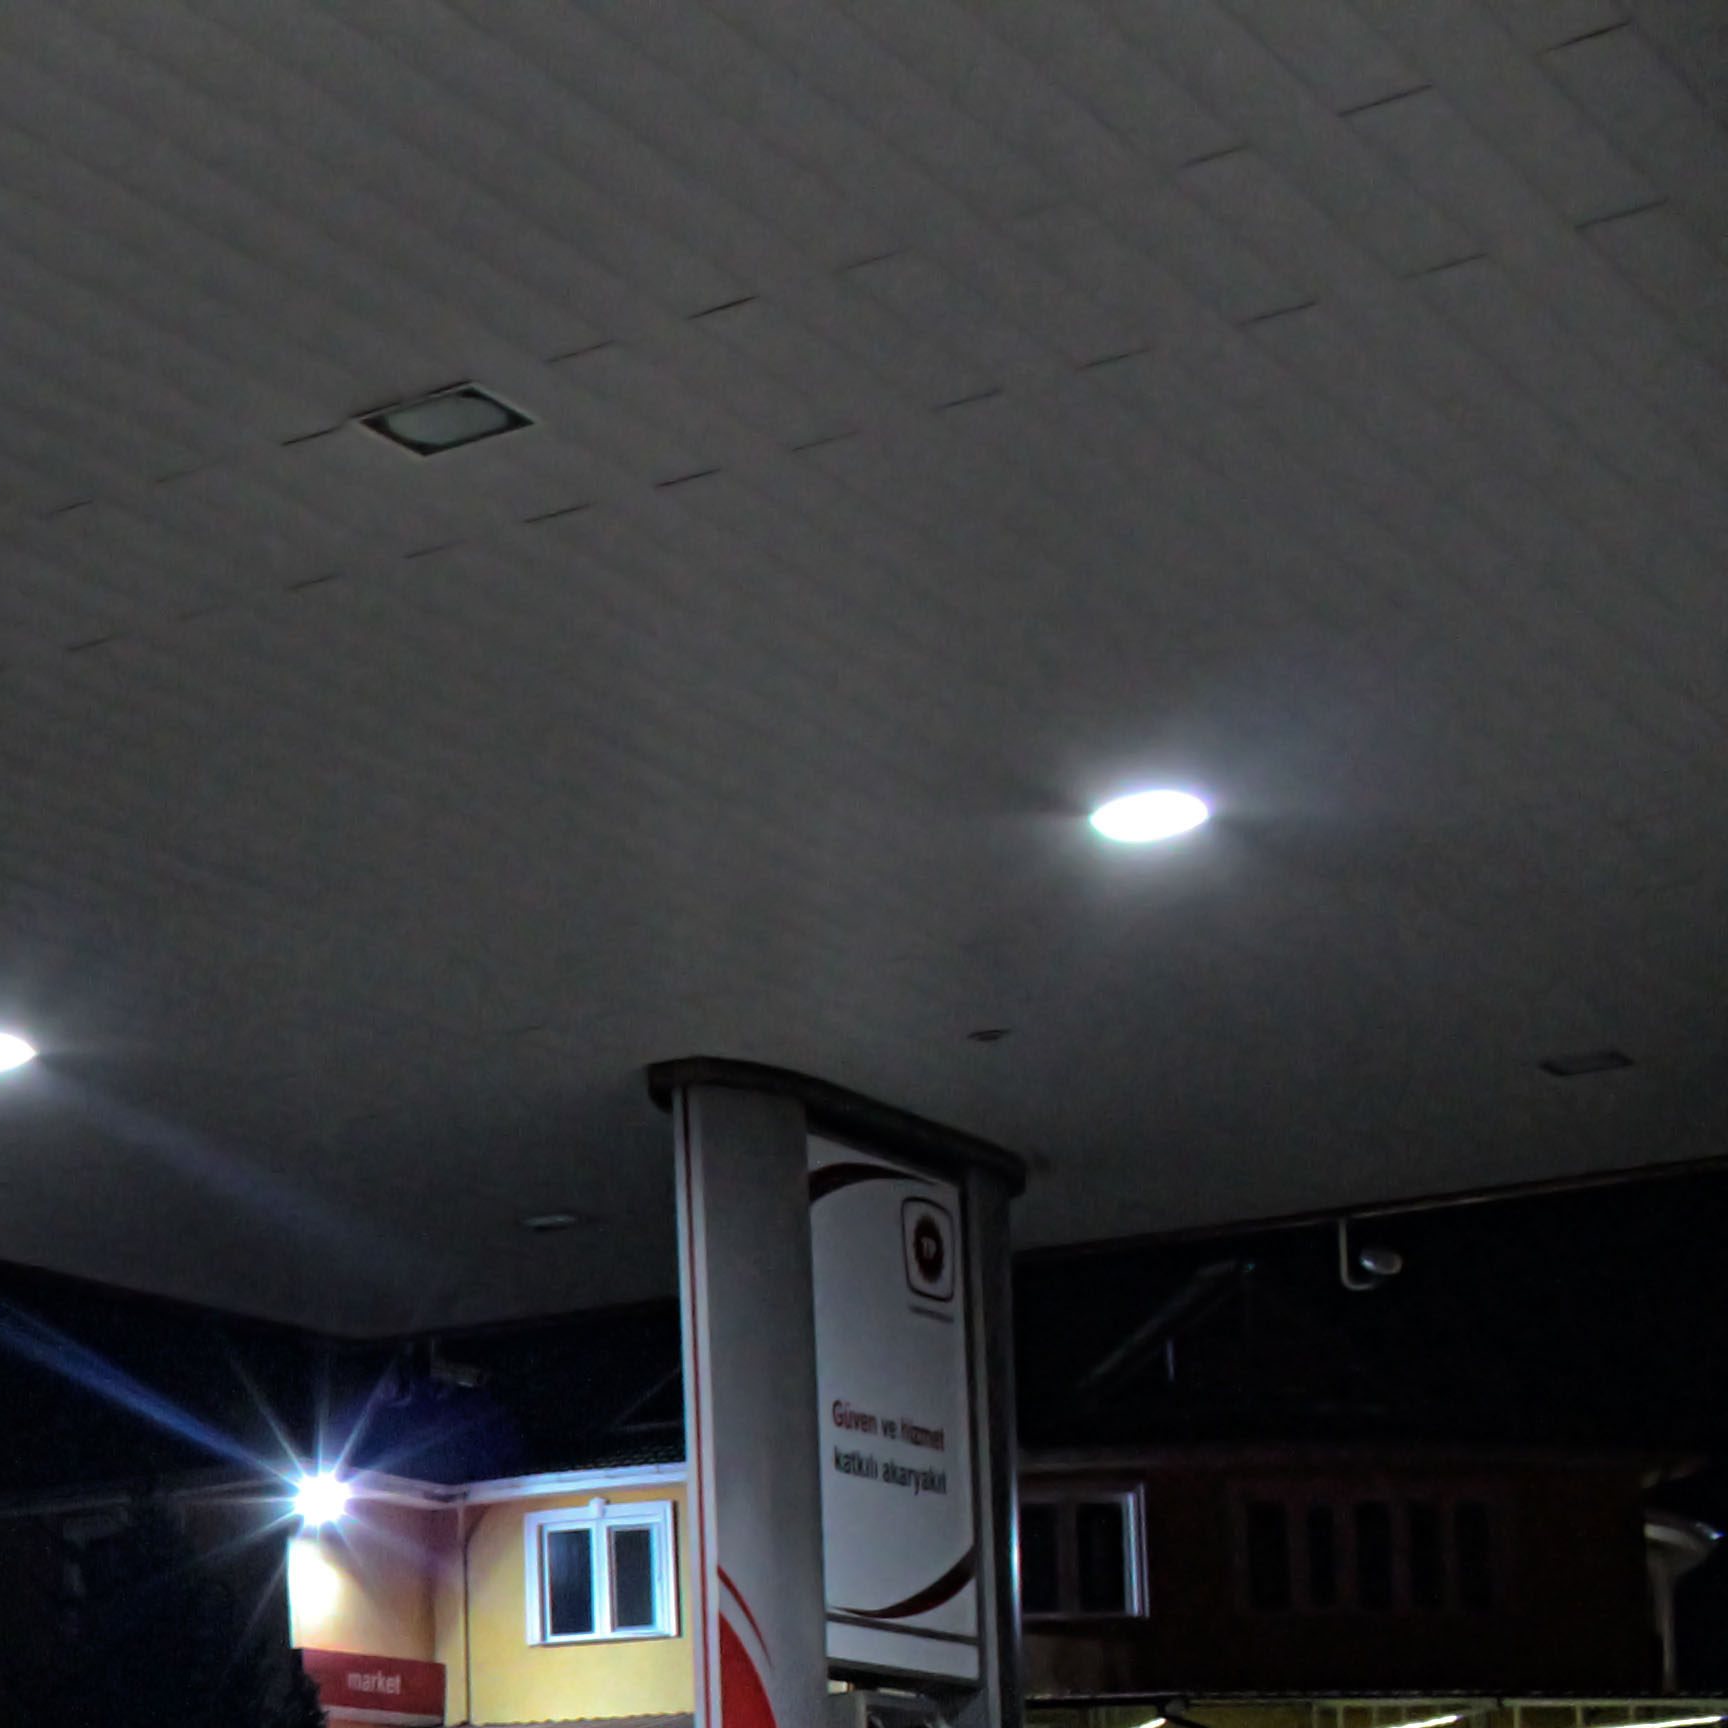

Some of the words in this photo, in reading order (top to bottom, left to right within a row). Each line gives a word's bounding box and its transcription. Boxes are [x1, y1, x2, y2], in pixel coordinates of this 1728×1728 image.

[832, 1400, 877, 1435] Güven
[881, 1418, 897, 1440] ve
[900, 1416, 945, 1451] hizmet
[346, 1670, 402, 1694] market
